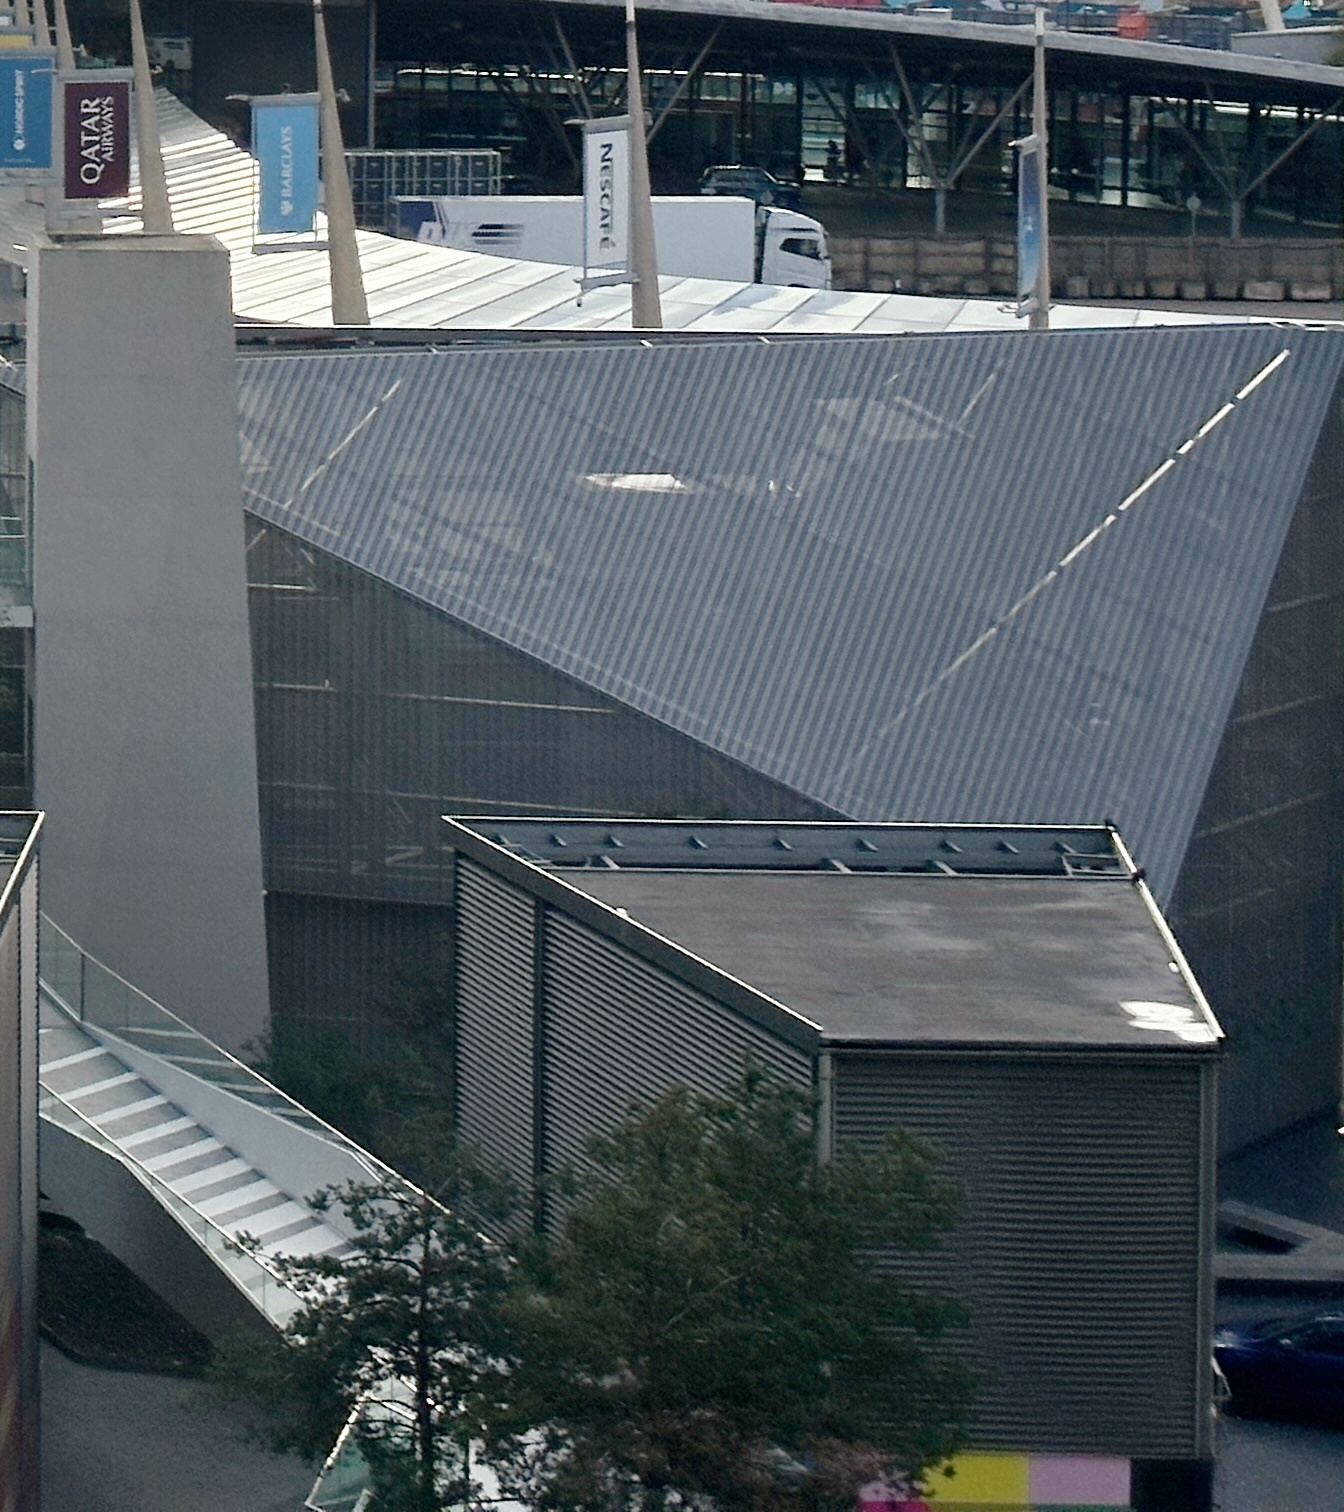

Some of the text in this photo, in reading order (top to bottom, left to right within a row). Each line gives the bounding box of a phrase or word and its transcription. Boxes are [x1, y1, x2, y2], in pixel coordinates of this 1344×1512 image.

[80, 97, 105, 185] QATAR
[101, 96, 114, 162] AIRWAYS
[280, 126, 293, 197] BARCLAYS
[598, 143, 617, 250] NESCAFÉ
